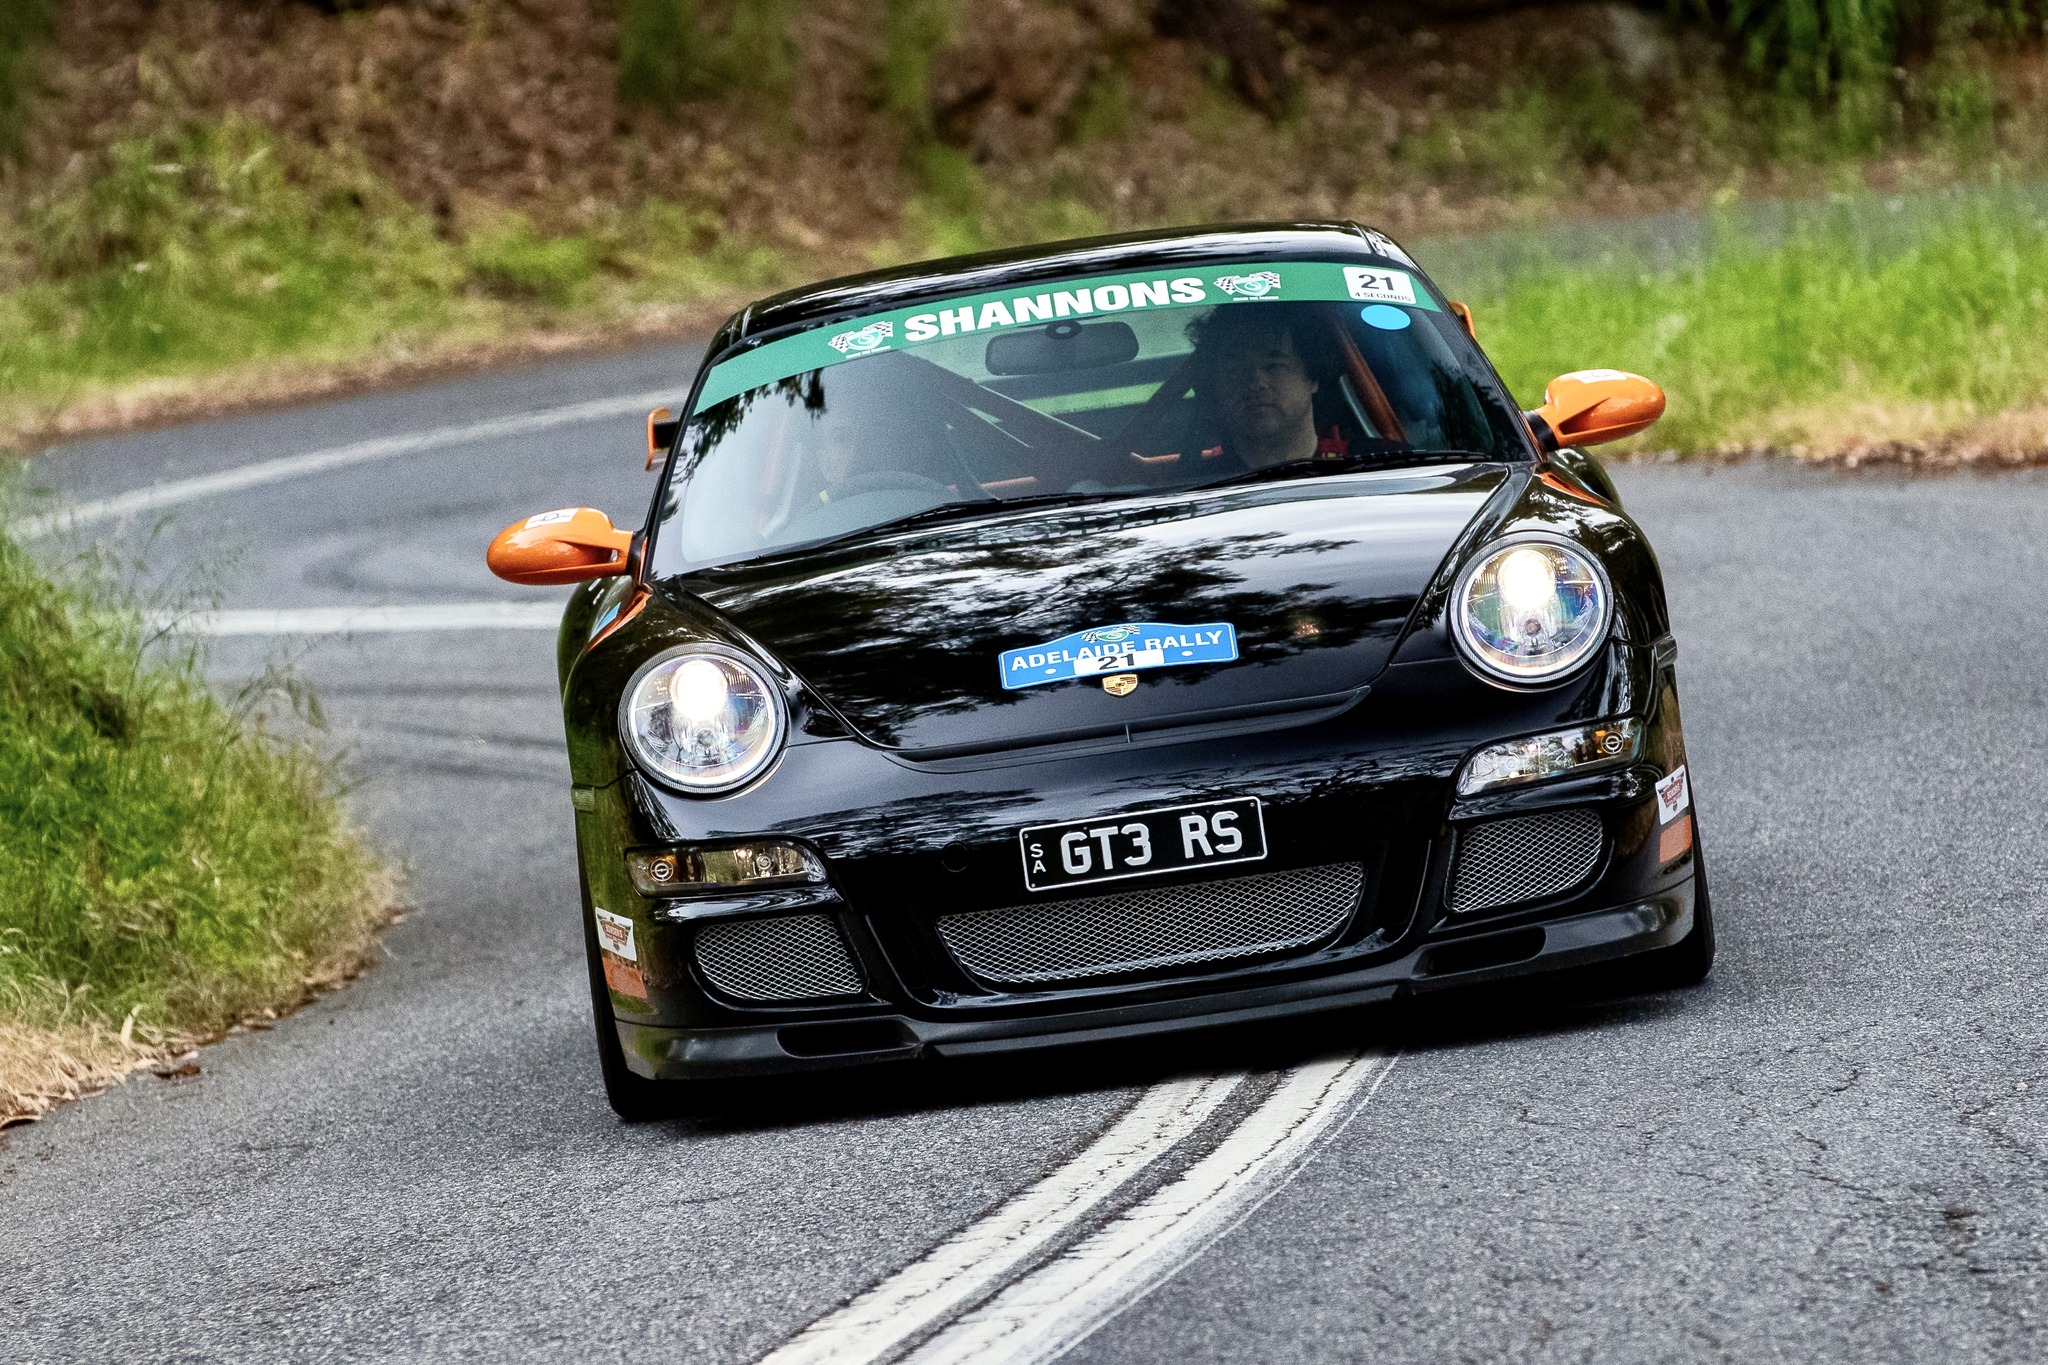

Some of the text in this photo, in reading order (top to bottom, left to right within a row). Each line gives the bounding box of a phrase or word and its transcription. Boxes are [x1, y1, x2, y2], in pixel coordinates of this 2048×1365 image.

[1358, 274, 1394, 291] 21
[1363, 292, 1411, 302] SECONDS
[904, 277, 1207, 342] SHANNONS
[1011, 630, 1223, 672] ADELAIDE RALLY
[1098, 653, 1134, 670] 21
[1060, 810, 1243, 875] GT3 RS
